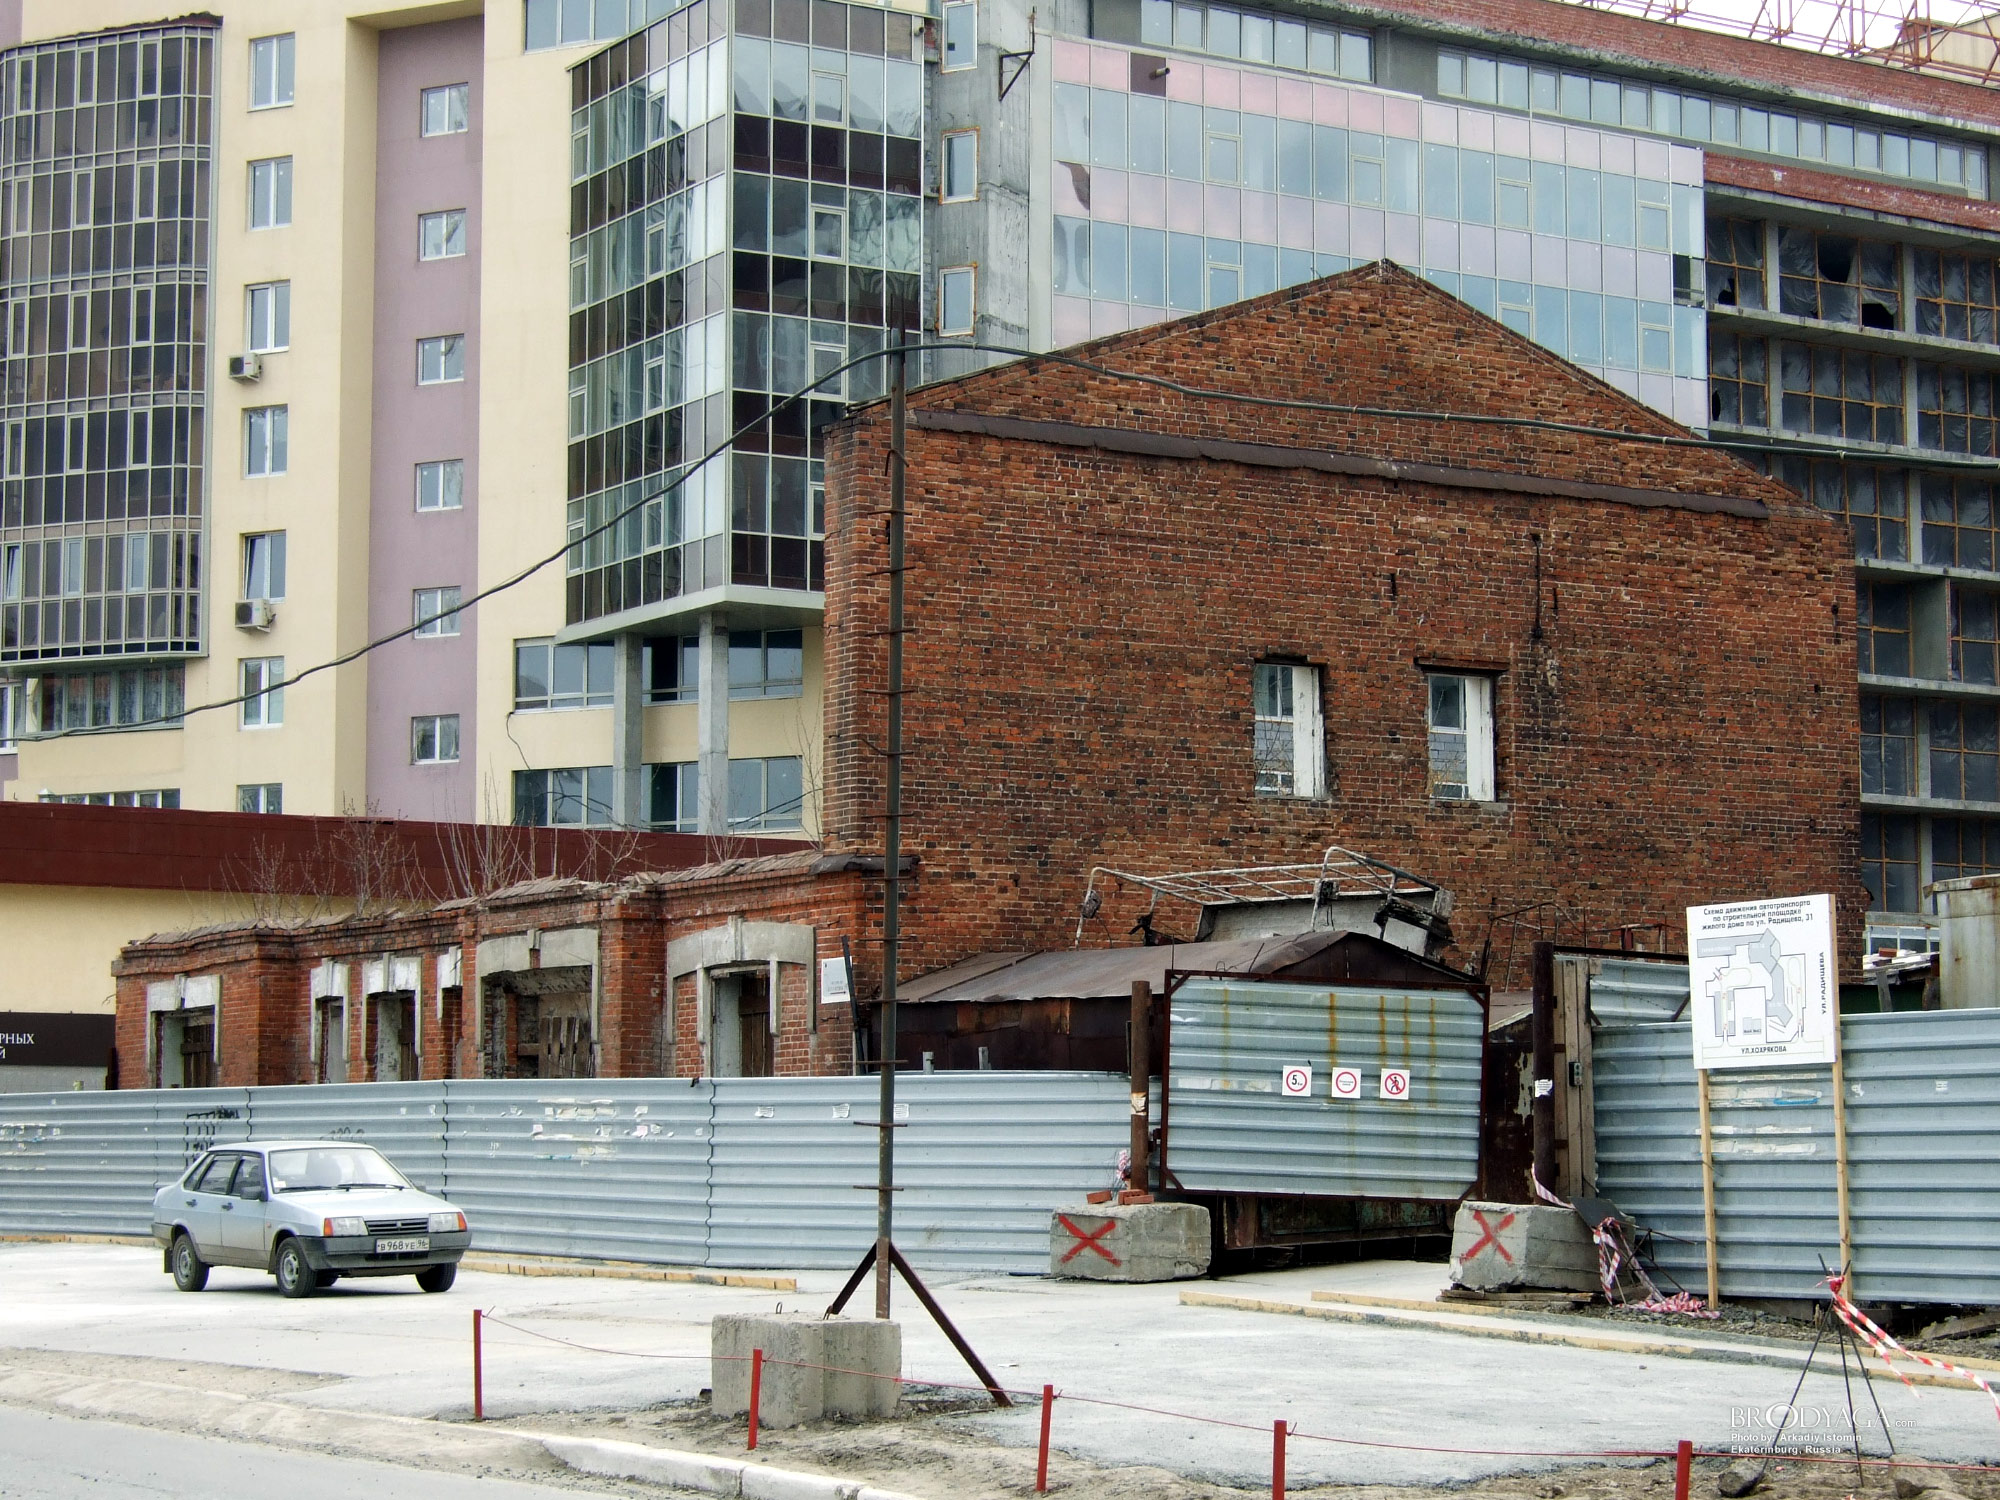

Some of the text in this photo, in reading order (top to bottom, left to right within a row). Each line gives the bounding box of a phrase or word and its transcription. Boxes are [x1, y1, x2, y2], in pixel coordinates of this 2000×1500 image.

[1703, 900, 1811, 915] Схема движения автотранспорта
[1702, 922, 1726, 930] жилого
[1727, 921, 1745, 929] дома
[1805, 913, 1814, 921] 31
[1722, 911, 1766, 922] строительной
[1767, 908, 1802, 917] площадке
[1291, 1074, 1298, 1086] 5
